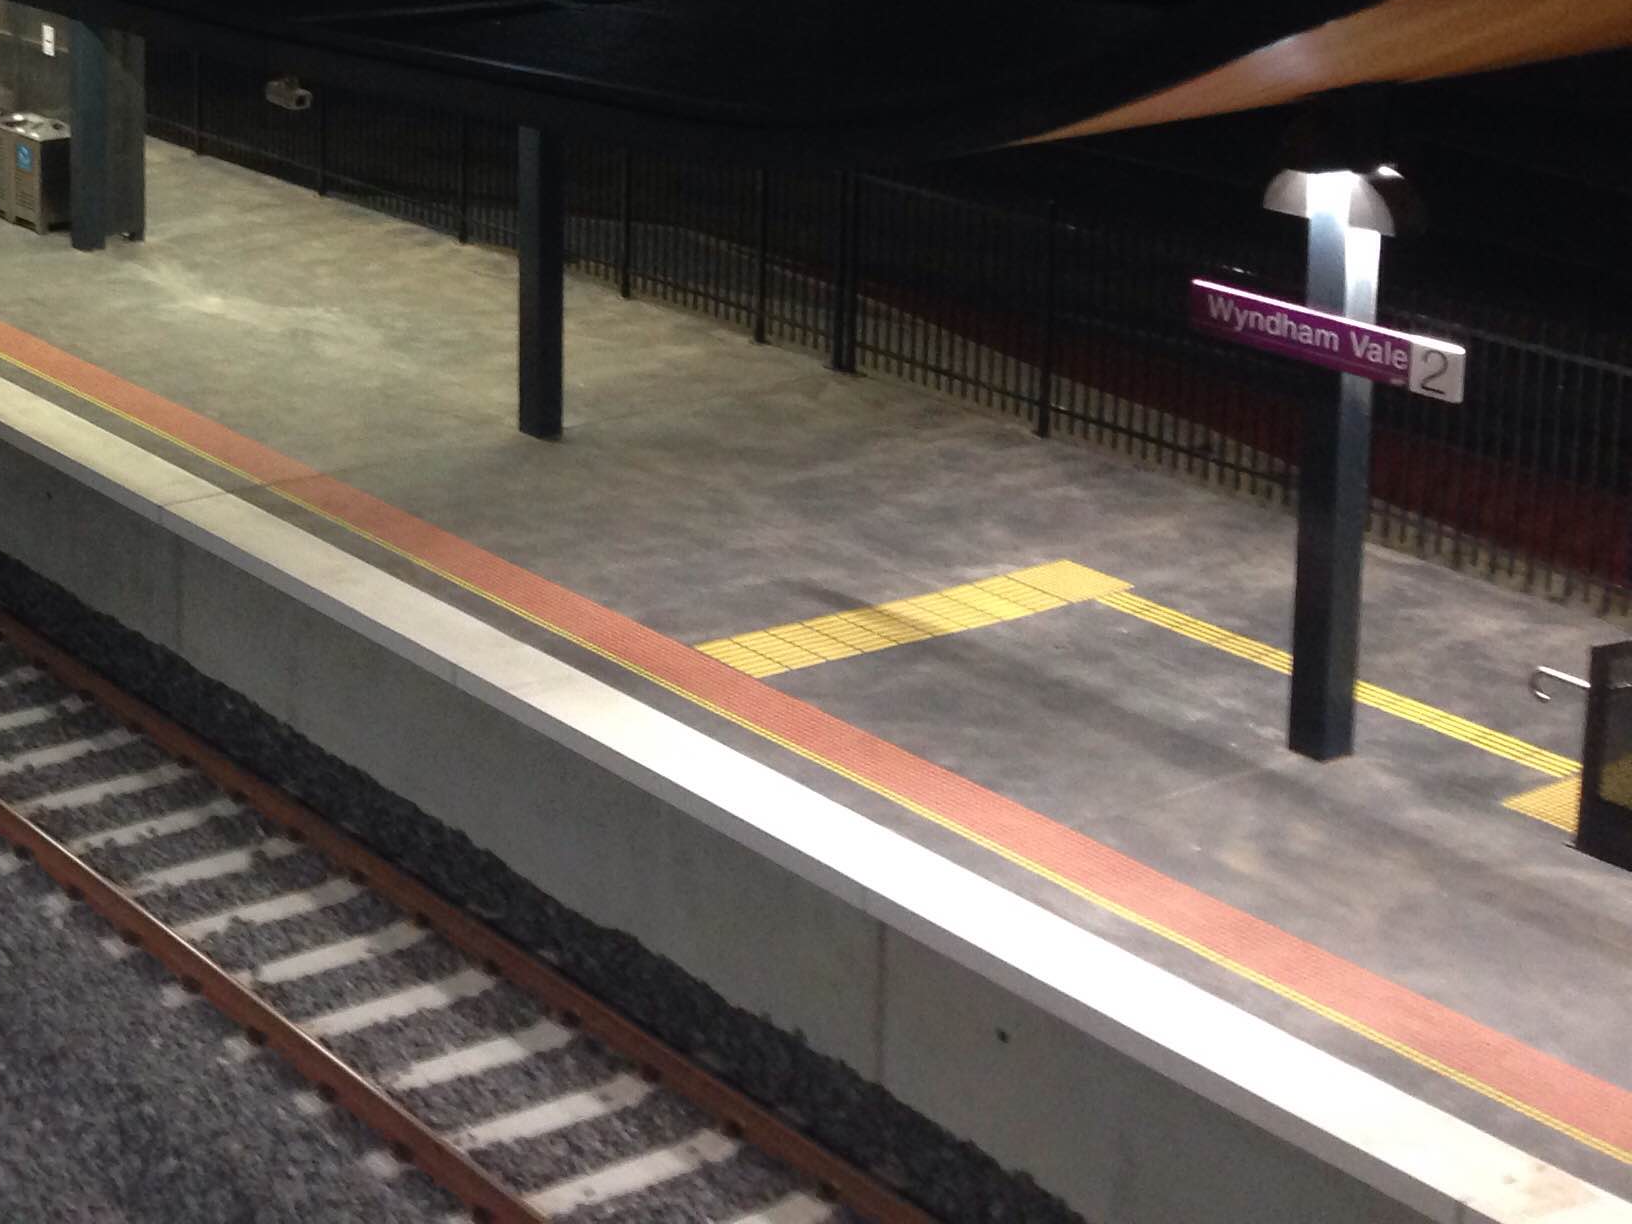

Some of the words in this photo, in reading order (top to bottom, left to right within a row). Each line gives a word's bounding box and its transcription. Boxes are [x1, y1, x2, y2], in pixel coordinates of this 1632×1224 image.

[1208, 292, 1340, 353] Wyndham
[1349, 330, 1409, 371] Vale
[1420, 349, 1450, 395] 2
